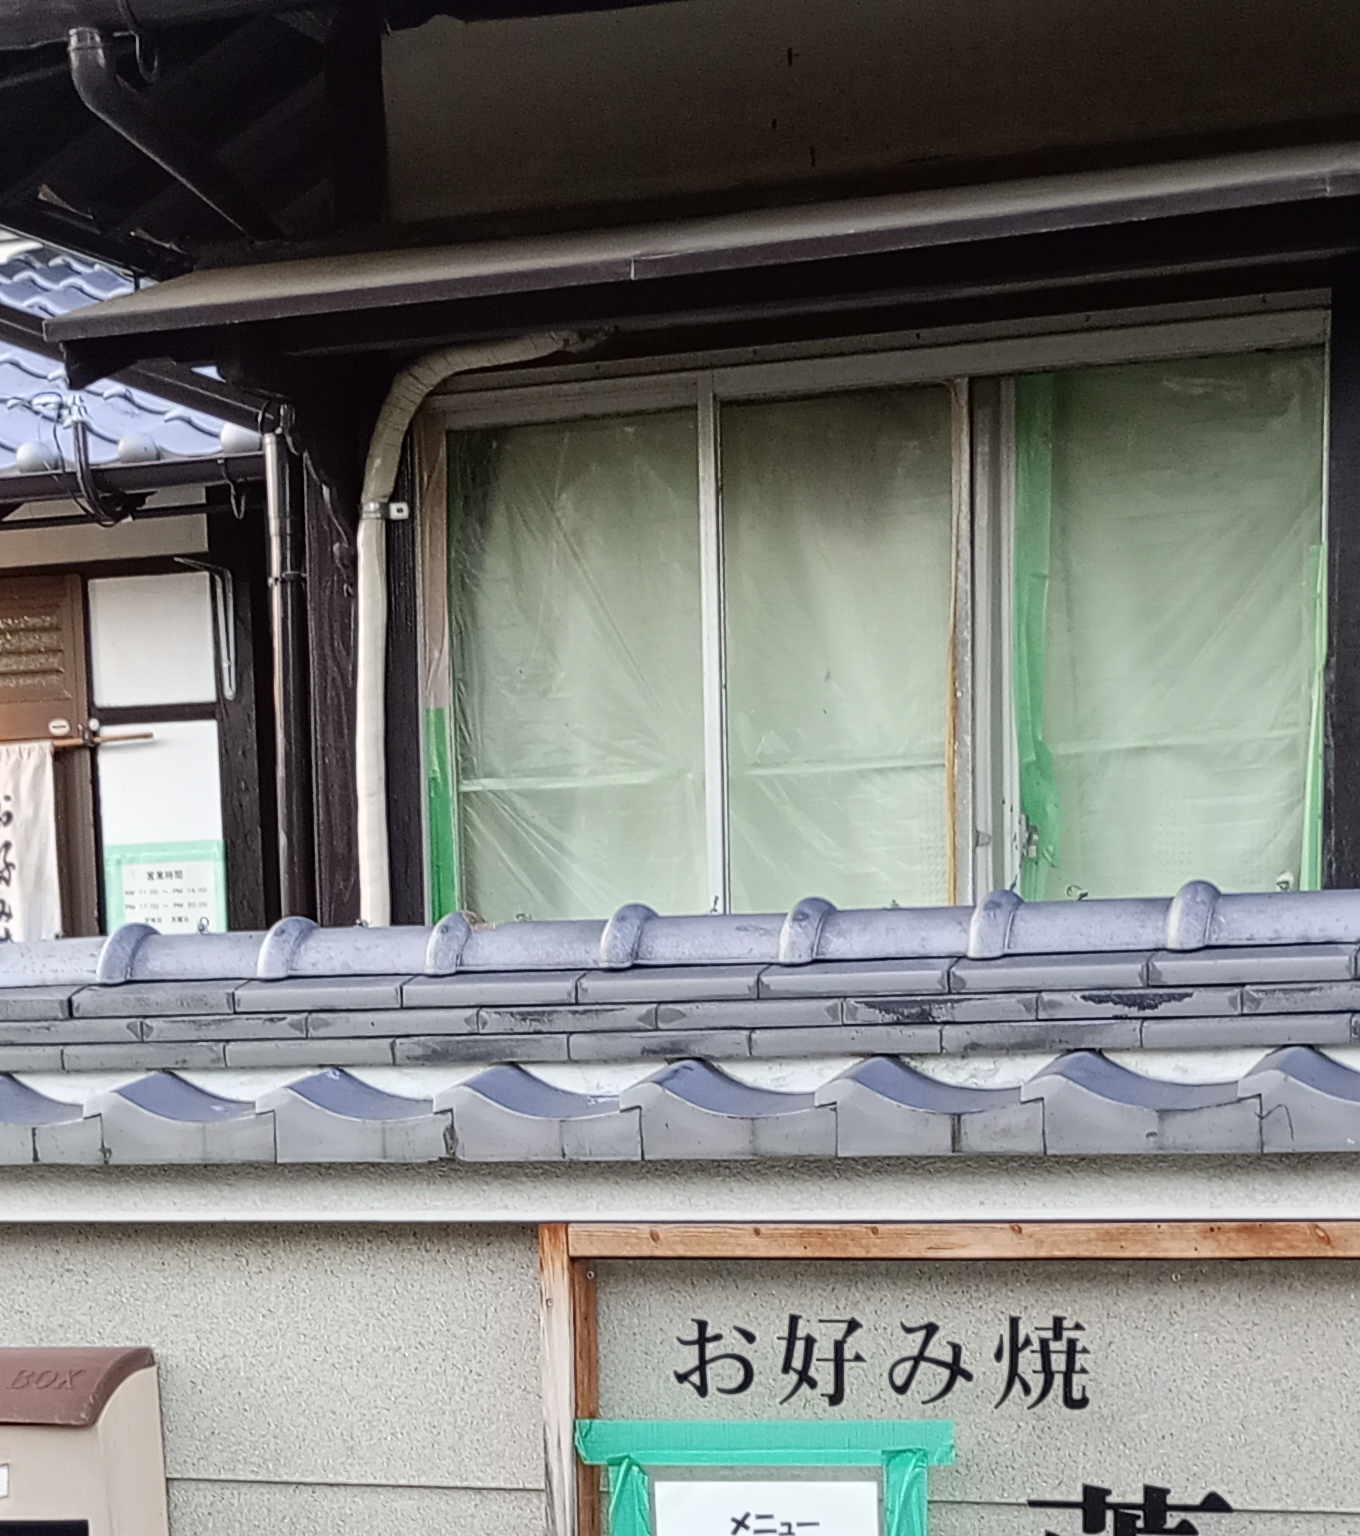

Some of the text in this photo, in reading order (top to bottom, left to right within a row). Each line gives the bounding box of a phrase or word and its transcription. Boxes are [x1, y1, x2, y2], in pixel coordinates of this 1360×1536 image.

[672, 1313, 1090, 1411] お好み焼
[7, 1369, 86, 1391] BOX
[730, 1511, 820, 1536] メニュー
